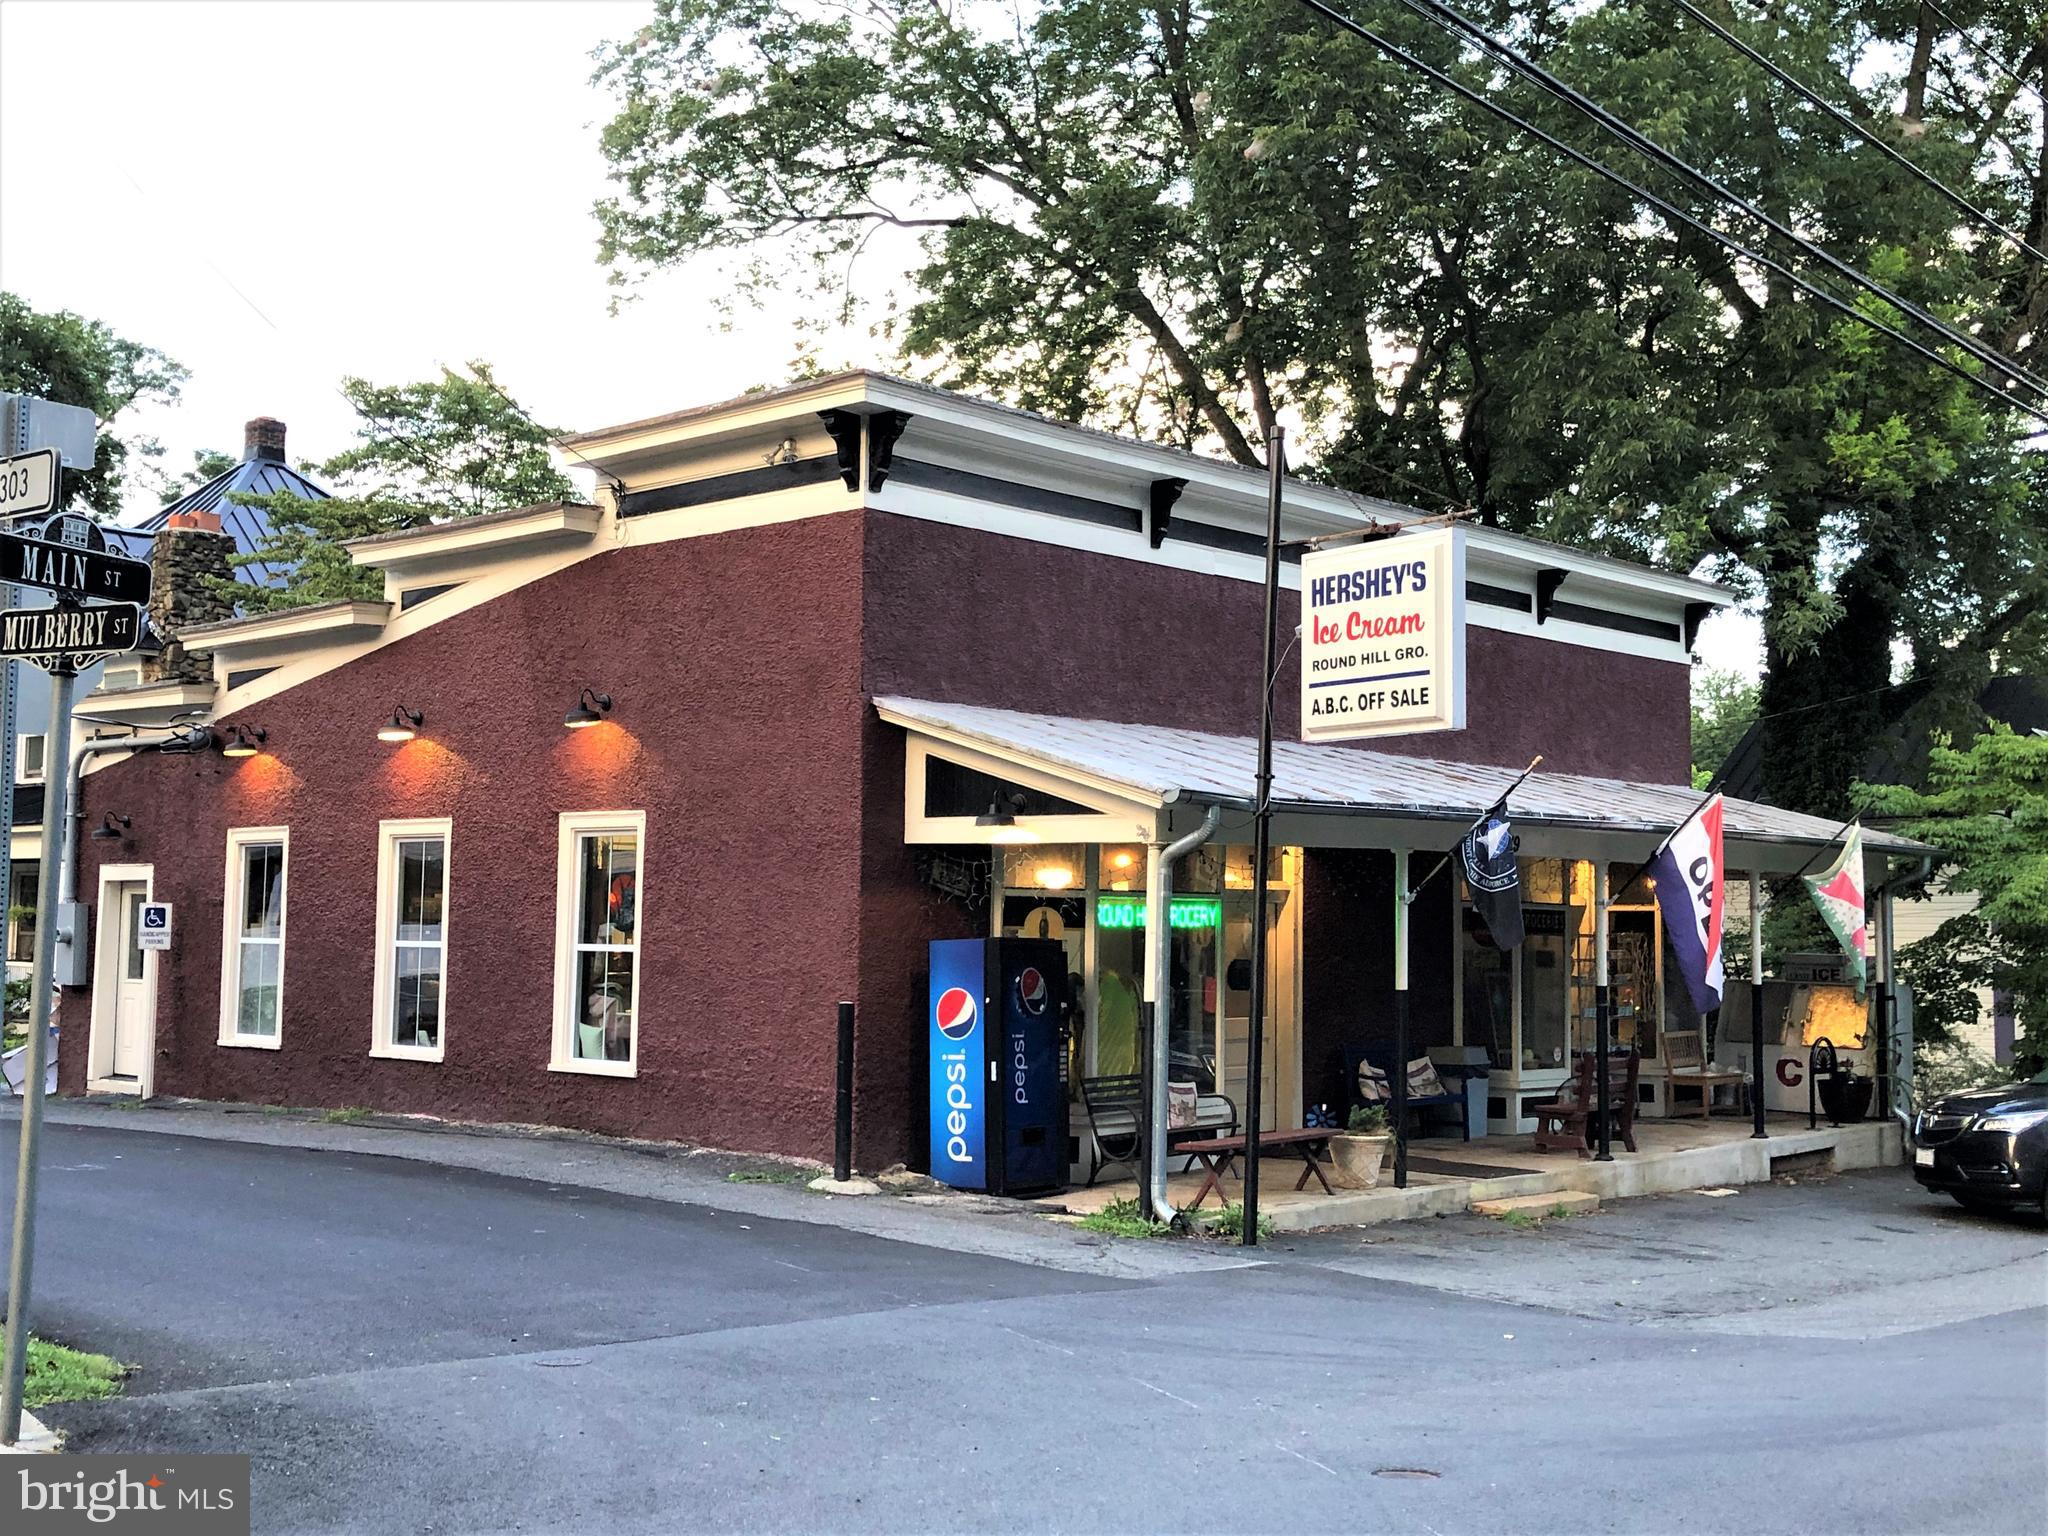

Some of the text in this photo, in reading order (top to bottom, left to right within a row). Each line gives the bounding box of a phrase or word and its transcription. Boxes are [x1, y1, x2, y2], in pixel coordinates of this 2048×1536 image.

[21, 545, 122, 590] MAIN ST
[1311, 561, 1426, 608] HERSHEY'S
[3, 611, 129, 651] MULBERRY ST
[1313, 611, 1425, 645] Ice Cream
[1312, 645, 1428, 672] ROUND HILL GRO.
[1312, 687, 1429, 715] A.B.C. OFF SALE
[1169, 904, 1217, 927] ROCERY
[1812, 968, 1840, 981] ICE
[1012, 1033, 1028, 1104] pepsi
[942, 1053, 973, 1162] pepsi
